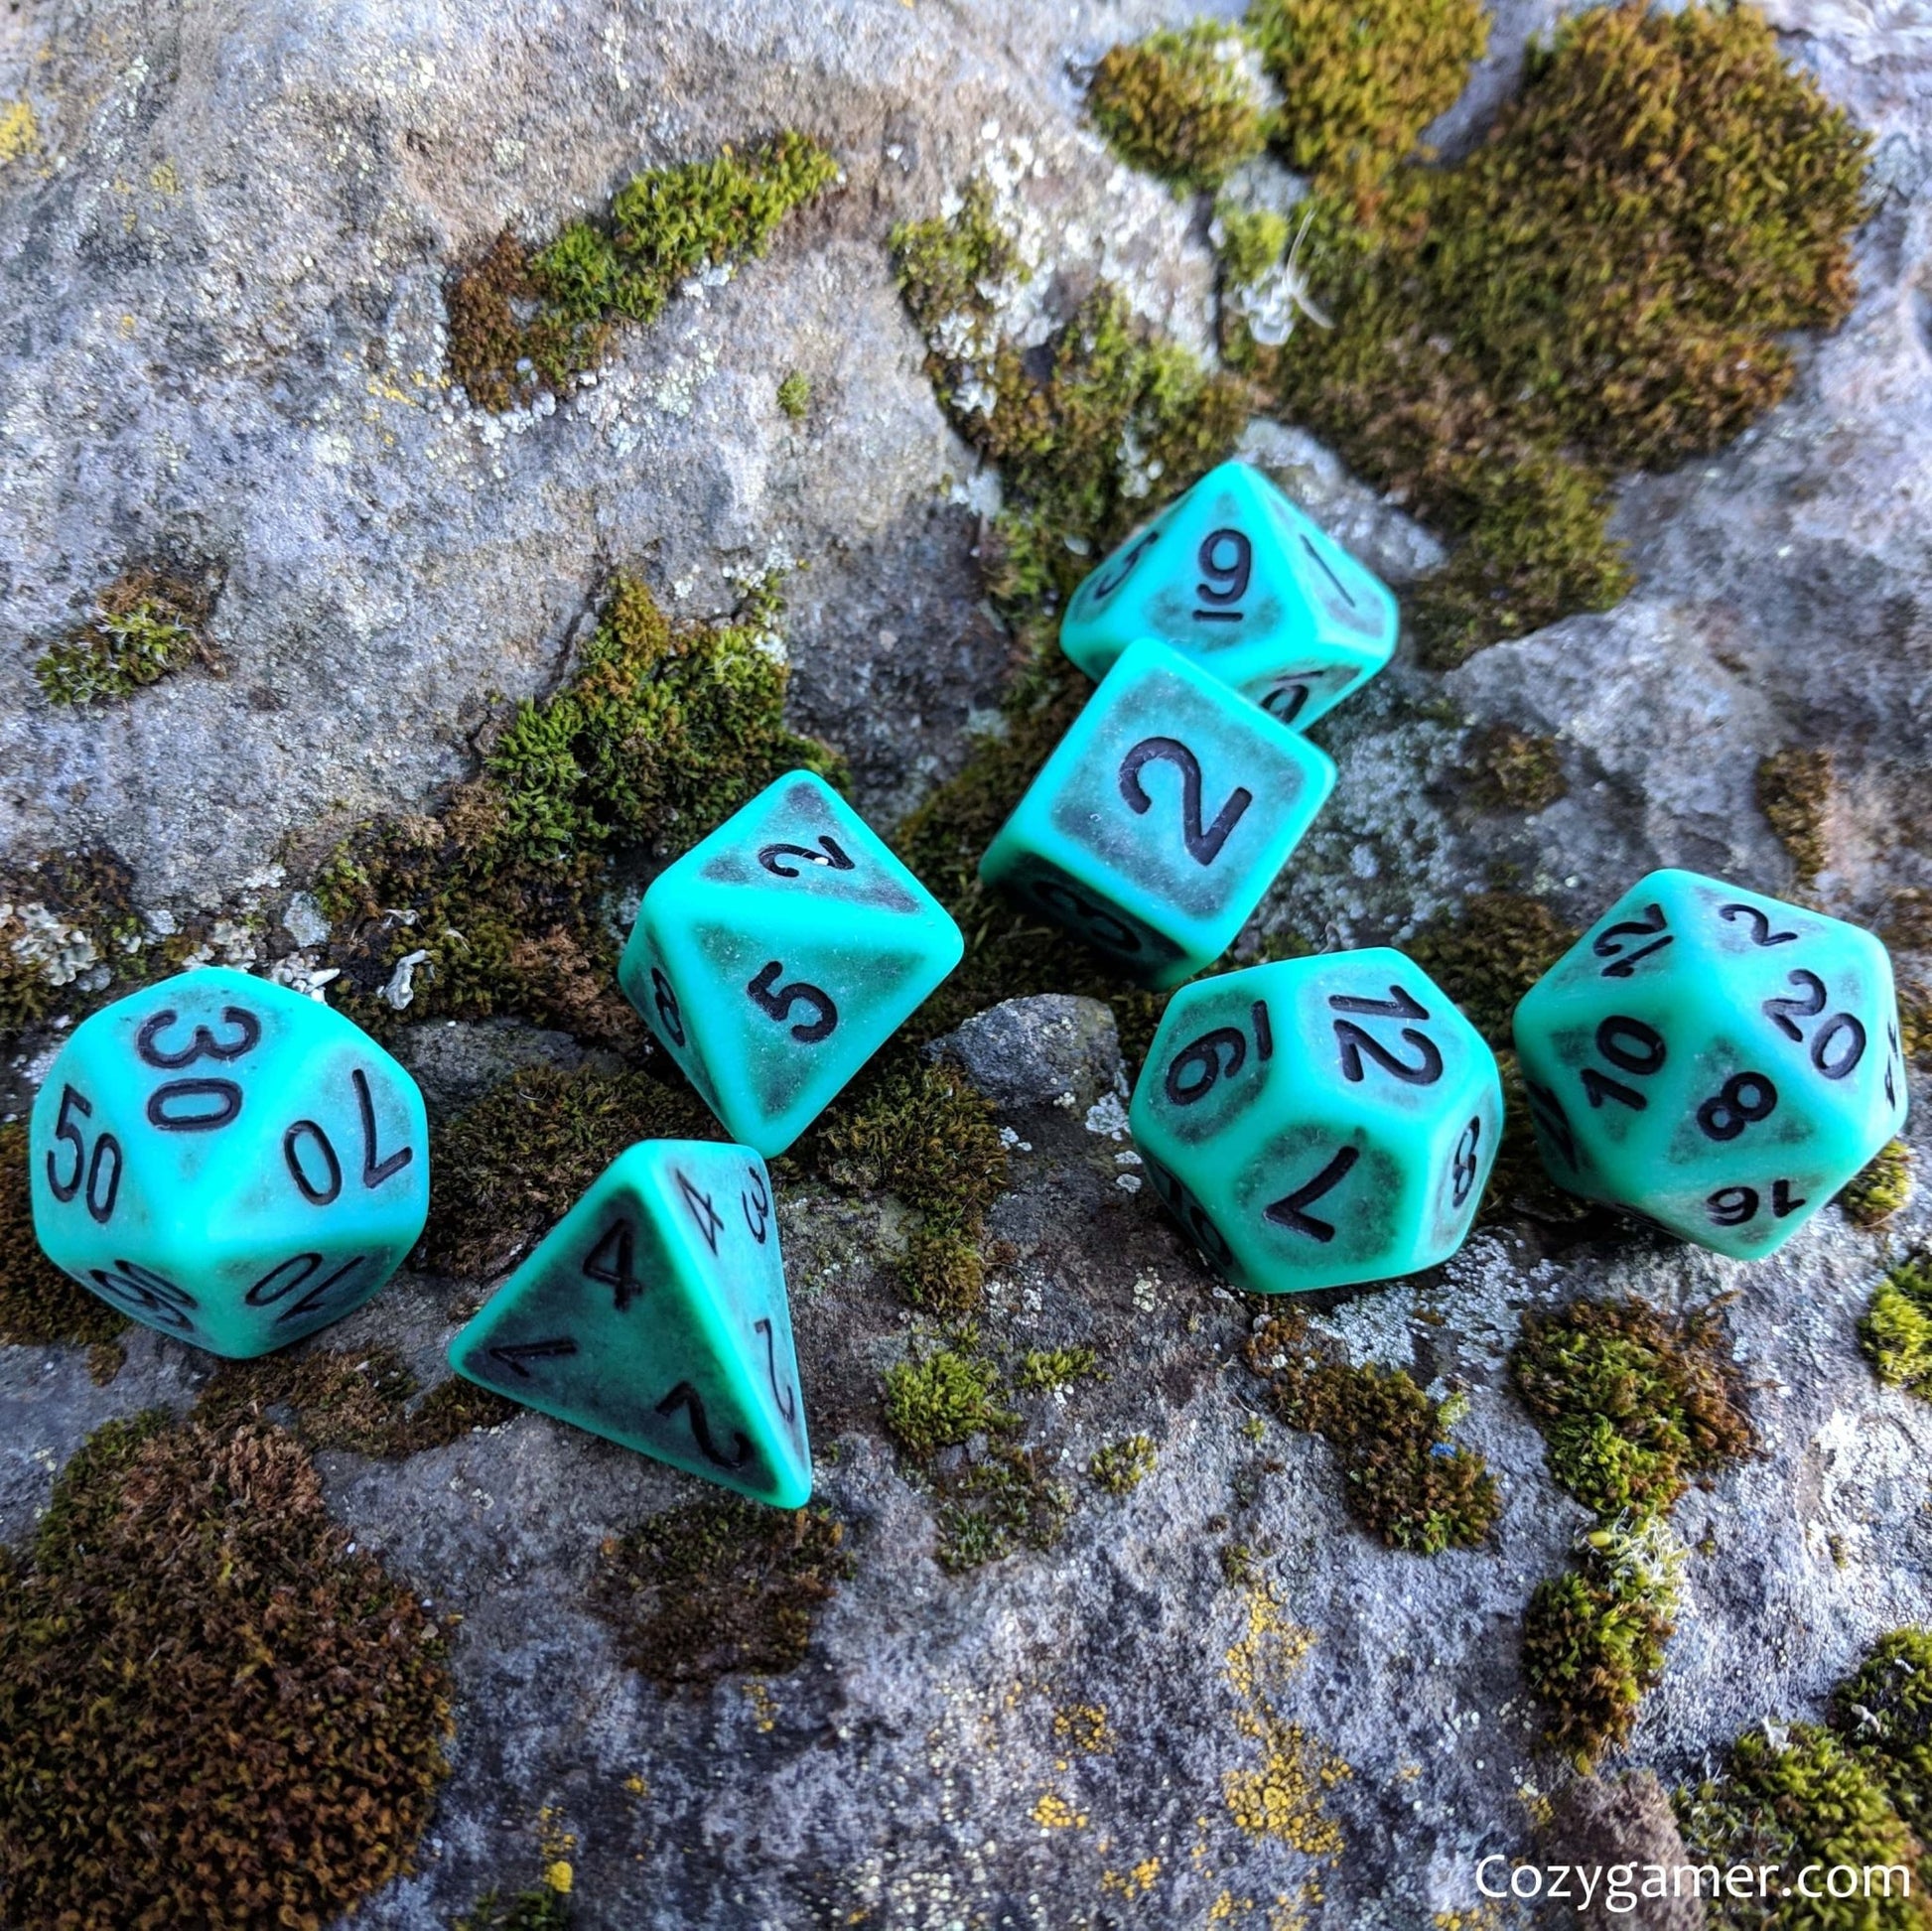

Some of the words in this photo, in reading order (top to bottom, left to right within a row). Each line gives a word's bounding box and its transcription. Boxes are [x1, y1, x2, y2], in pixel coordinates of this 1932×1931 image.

[1192, 528, 1252, 622] 9
[1118, 736, 1253, 867] 2
[759, 835, 856, 879] 2
[1593, 902, 1674, 978] 12
[1719, 903, 1799, 947] 2
[651, 967, 686, 1048] 8
[748, 960, 838, 1043] 5
[1328, 985, 1444, 1086] 12
[1762, 968, 1867, 1080] 20
[135, 1006, 261, 1132] 30
[1581, 1015, 1667, 1111] 10
[1697, 1071, 1778, 1142] 8
[47, 1083, 122, 1223] 50
[283, 1068, 413, 1205] 70
[1452, 1115, 1480, 1209] 8
[676, 1169, 725, 1256] 4
[742, 1167, 769, 1244] 3
[1264, 1146, 1360, 1243] 7
[583, 1217, 643, 1311] 4
[488, 1336, 578, 1378] 1
[654, 1380, 752, 1469] 2
